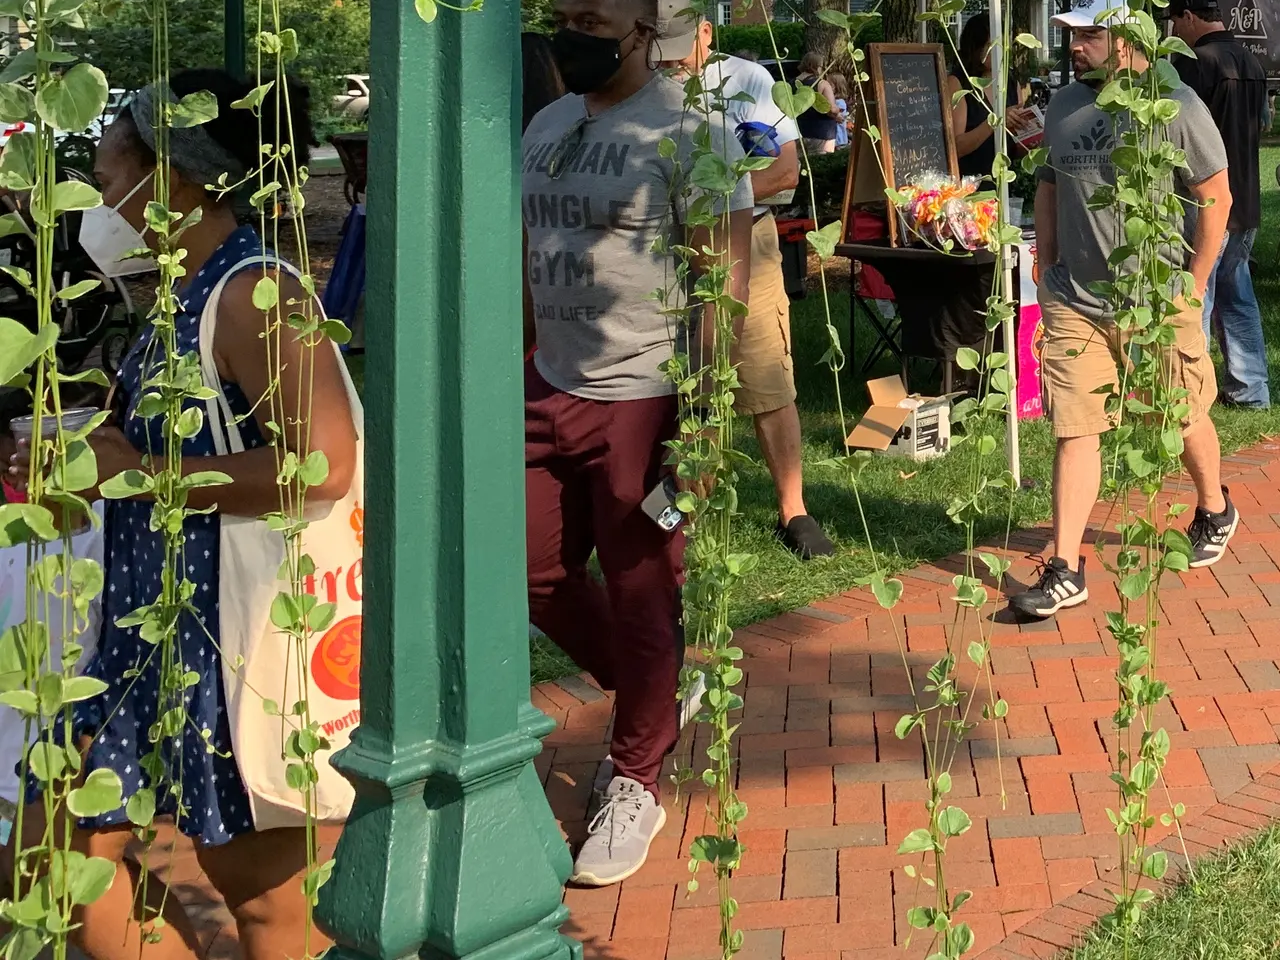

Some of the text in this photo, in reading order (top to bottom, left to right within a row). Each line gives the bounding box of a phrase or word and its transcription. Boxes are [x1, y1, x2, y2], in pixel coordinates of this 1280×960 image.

[1228, 6, 1263, 33] N&P
[1060, 154, 1097, 164] NORTH
[529, 250, 596, 288] GYM
